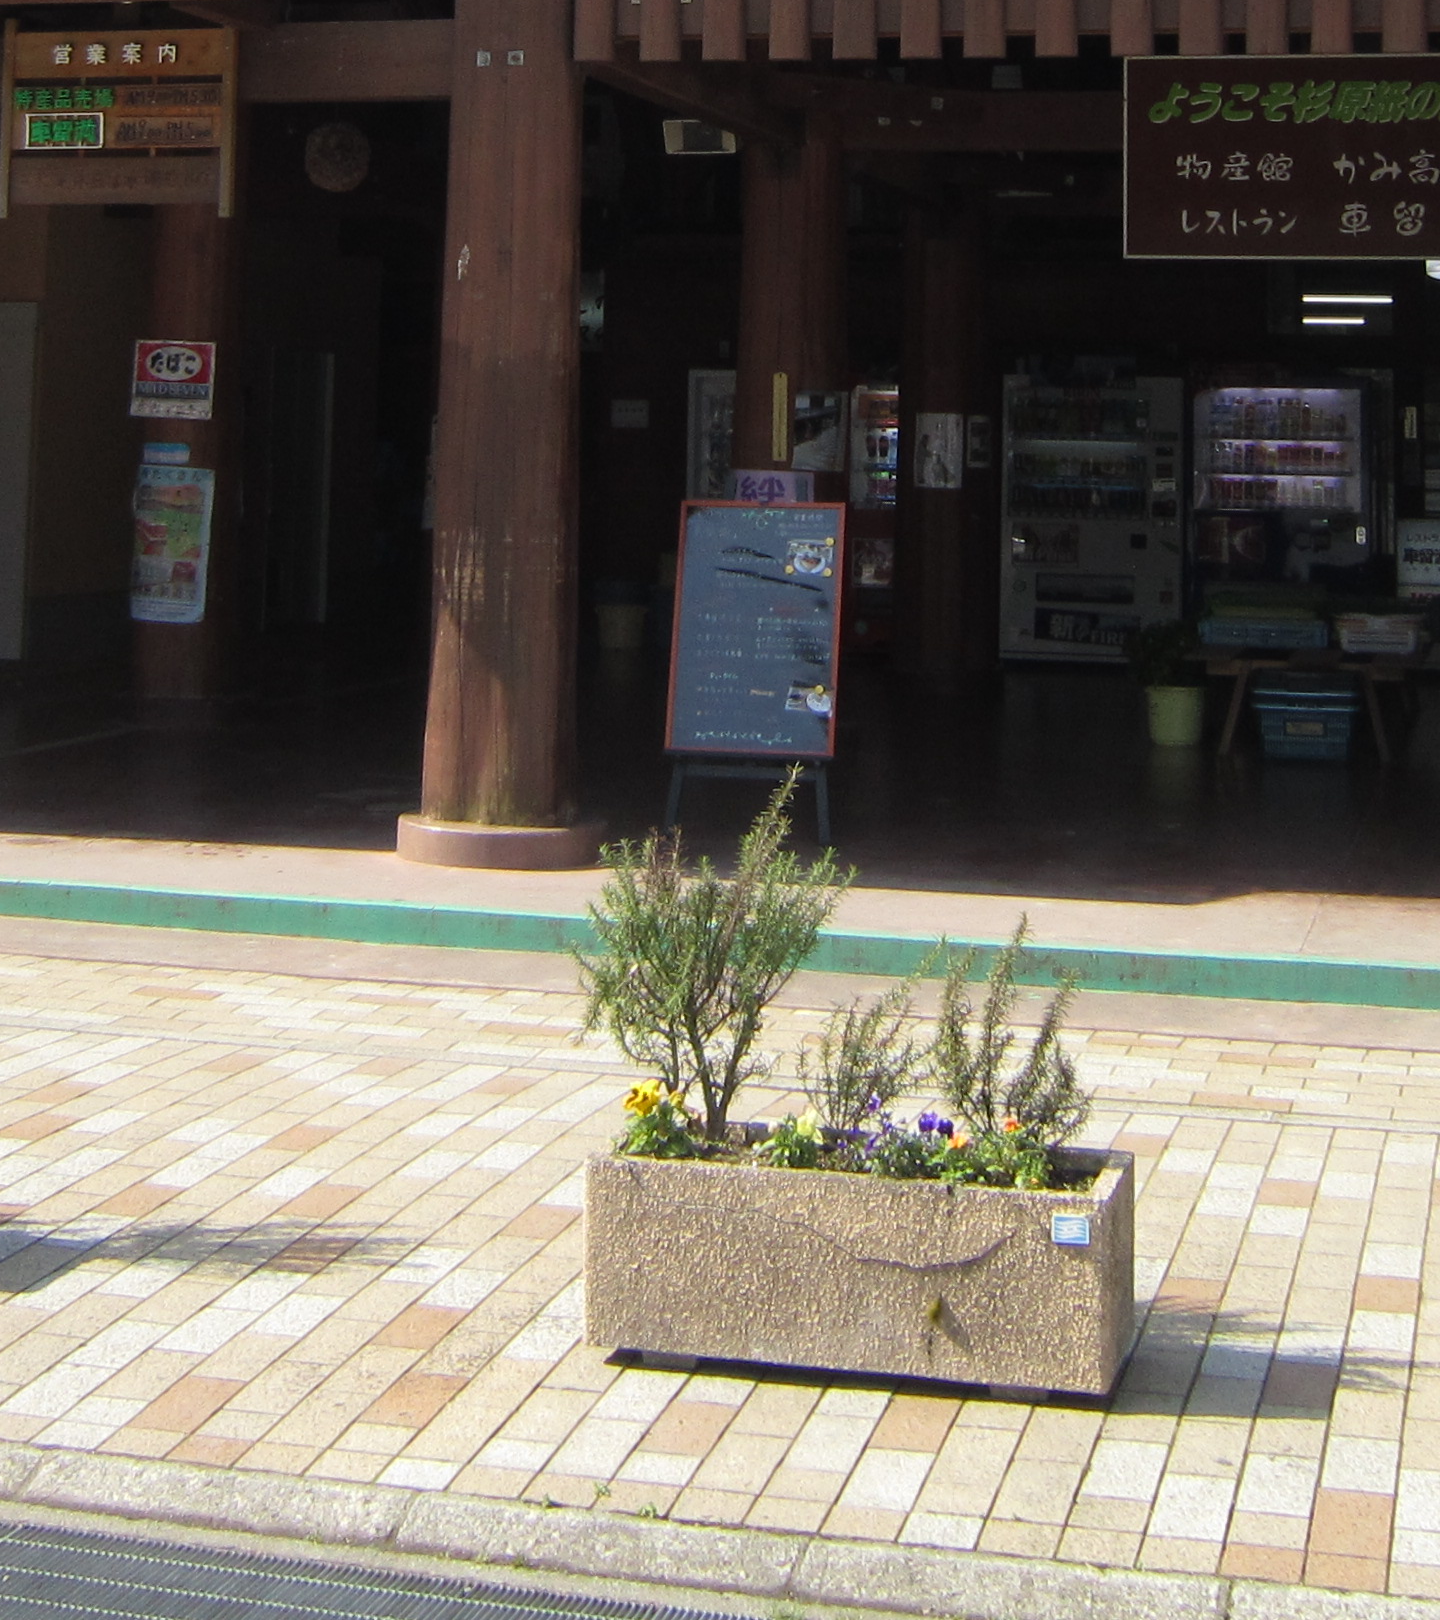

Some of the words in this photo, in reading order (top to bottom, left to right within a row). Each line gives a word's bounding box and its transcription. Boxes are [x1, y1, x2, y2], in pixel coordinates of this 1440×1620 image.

[53, 42, 178, 65] 営業案内
[1175, 151, 1295, 181] 物産館
[1180, 208, 1298, 237] レストラン
[150, 351, 197, 375] たばこ
